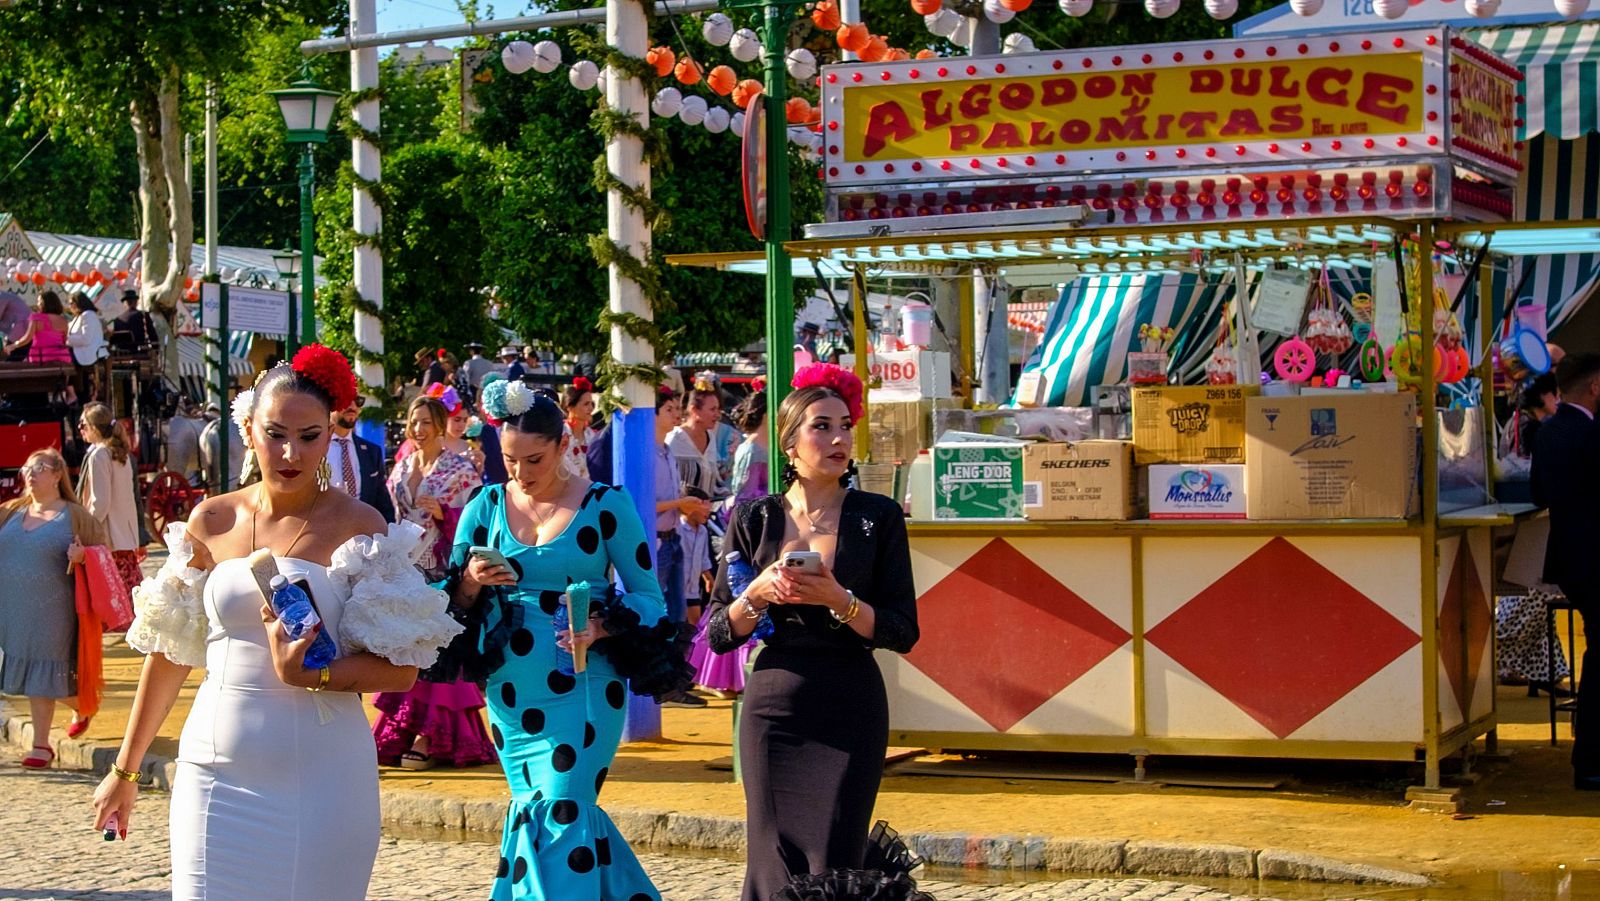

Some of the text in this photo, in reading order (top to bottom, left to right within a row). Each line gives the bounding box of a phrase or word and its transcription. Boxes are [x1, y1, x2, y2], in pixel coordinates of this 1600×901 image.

[863, 72, 1156, 157] ALGODON
[1189, 66, 1414, 125] DULCE
[949, 104, 1305, 151] PALOMITAS
[1172, 407, 1207, 425] JUICY
[1178, 418, 1202, 431] DROP
[1040, 459, 1111, 469] SKECHERS
